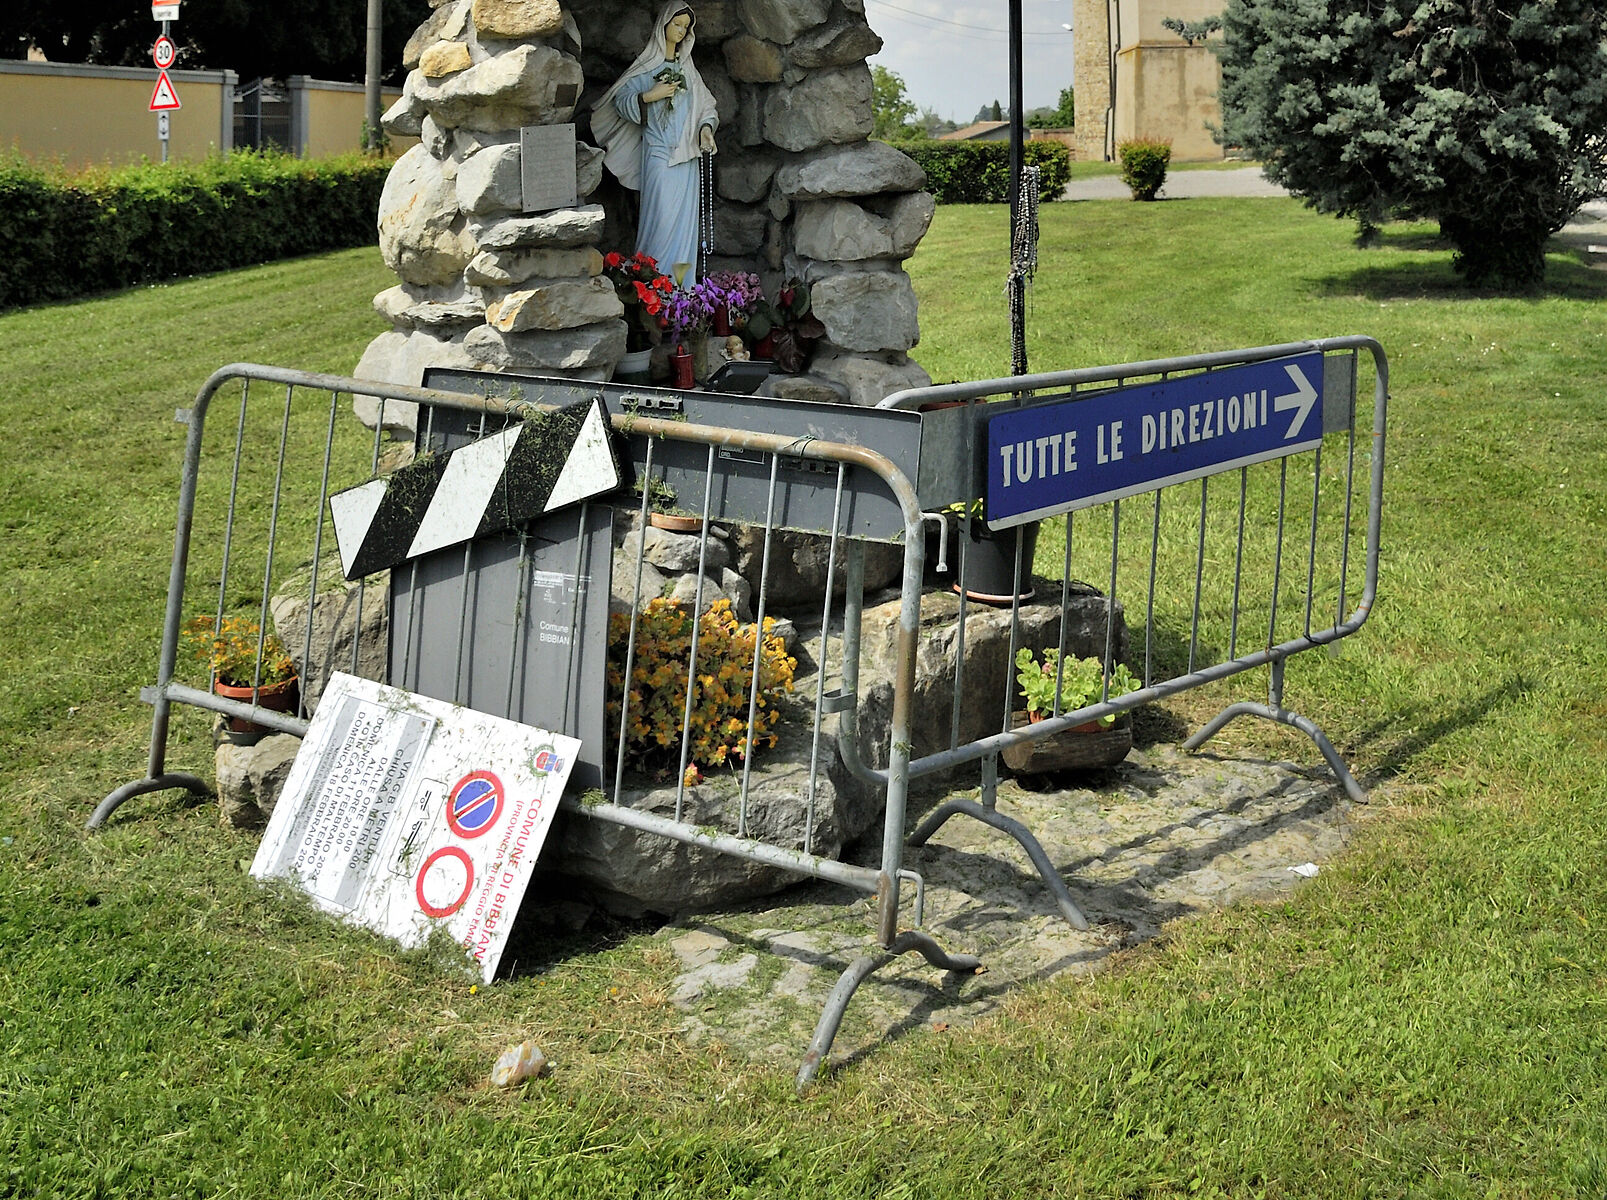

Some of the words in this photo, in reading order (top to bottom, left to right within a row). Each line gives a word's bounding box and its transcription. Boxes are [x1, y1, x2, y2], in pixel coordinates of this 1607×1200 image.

[158, 45, 170, 59] 30
[1000, 430, 1078, 488] TUTTE
[1096, 420, 1123, 465] LE
[1141, 389, 1268, 455] DIREZIONI
[539, 620, 569, 633] Comune
[539, 632, 576, 646] BIBBIAN
[335, 711, 366, 770] DOMENICA
[355, 737, 365, 749] IN
[360, 726, 369, 735] O
[353, 716, 384, 776] DOMENICA
[329, 773, 338, 785] 18
[339, 751, 358, 783] CASO
[359, 757, 377, 786] ALLE
[367, 756, 388, 793] DALLE
[379, 748, 404, 793] CHIUSA
[397, 759, 411, 780] VIA
[334, 786, 343, 797] DI
[347, 780, 356, 790] 11
[348, 788, 363, 813] ORE
[355, 796, 371, 821] ORE
[374, 795, 384, 805] A
[303, 787, 333, 846] FEBBRAIO
[321, 794, 351, 853] FEBBRAIO
[334, 815, 352, 845] 20.00
[357, 807, 378, 846] METRI
[306, 799, 338, 865] MALTEMPO
[342, 824, 359, 852] 10.00
[362, 809, 389, 864] VENTURI
[507, 797, 542, 869] COMUNE
[310, 855, 325, 881] 2024
[348, 848, 362, 869] 200
[499, 872, 514, 889] DI
[474, 875, 495, 916] REGGIO
[472, 892, 506, 961] BIBBIAN
